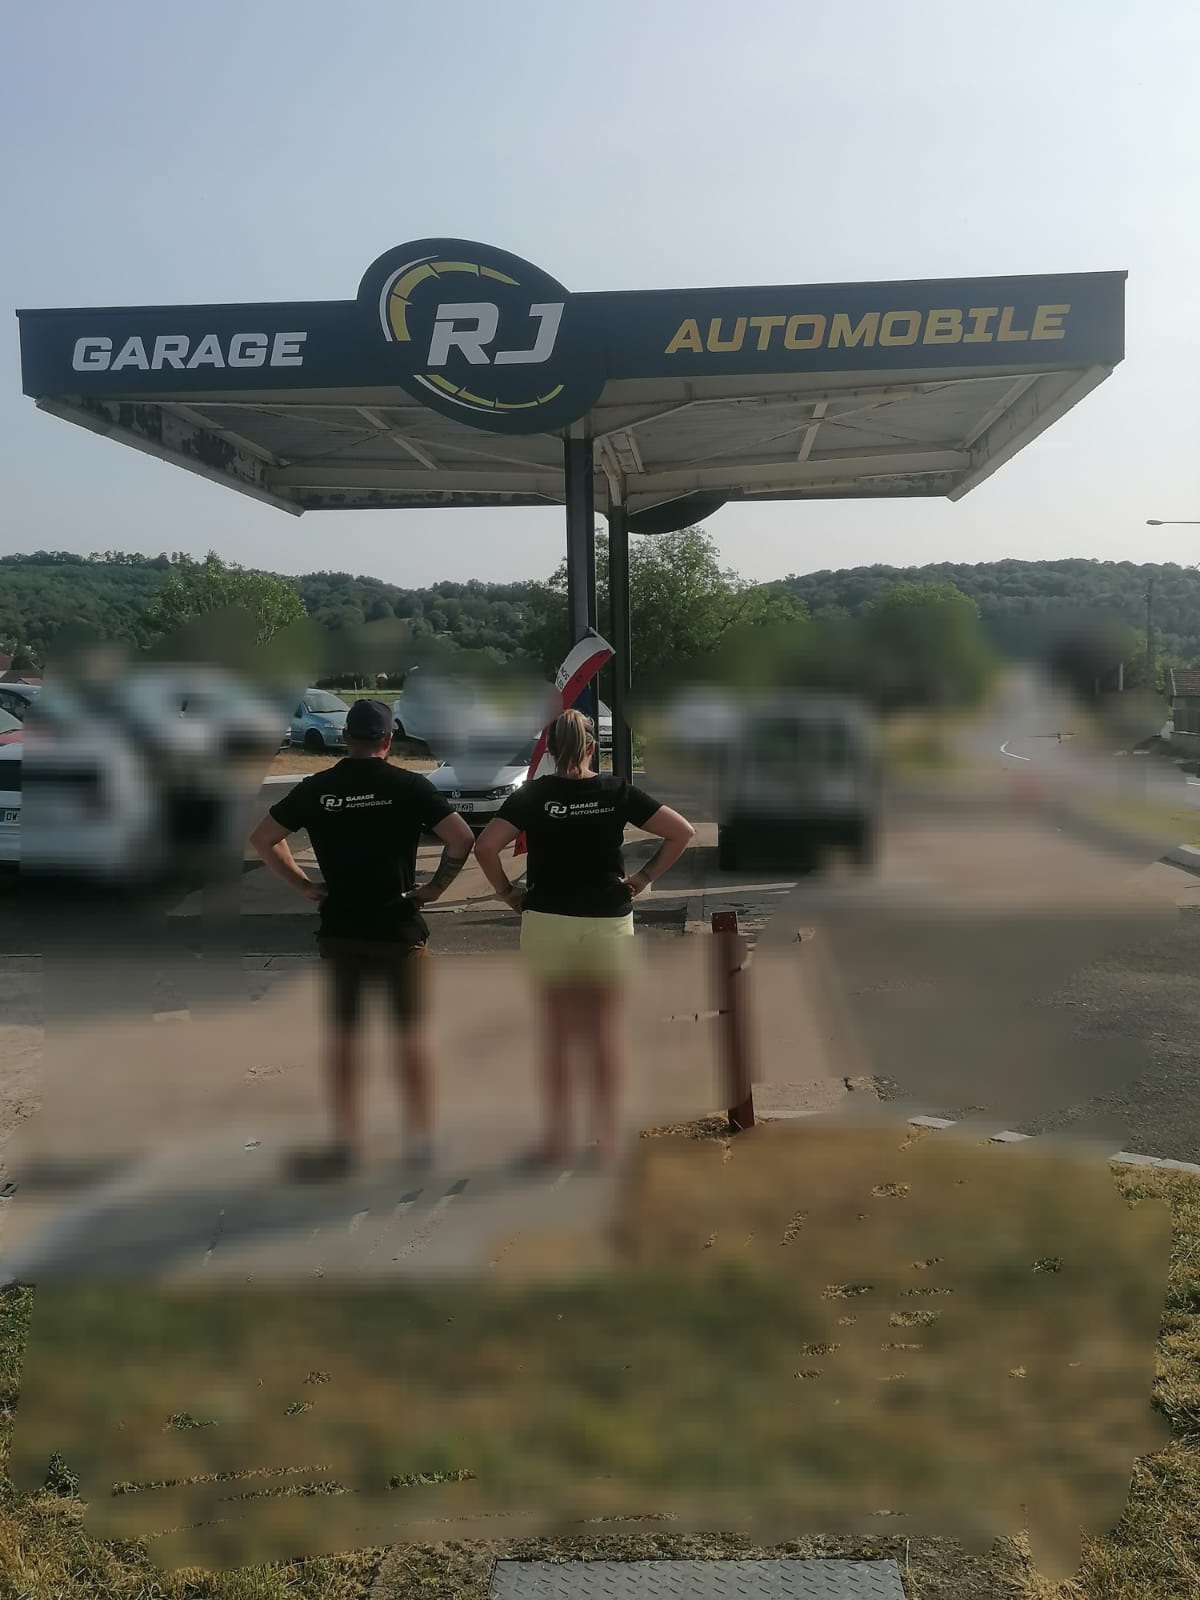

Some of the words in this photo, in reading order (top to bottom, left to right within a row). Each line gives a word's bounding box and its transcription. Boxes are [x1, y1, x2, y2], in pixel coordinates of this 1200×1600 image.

[427, 302, 565, 366] RJ
[664, 304, 1071, 354] AUTOMOBILE
[72, 332, 308, 371] GARAGE
[325, 798, 343, 807] RJ
[345, 794, 375, 802] GARAGE
[345, 799, 393, 809] AUTOMOBILE
[569, 801, 599, 809] GARAGE
[550, 805, 568, 814] RJ
[569, 806, 616, 816] AUTOMOBILE
